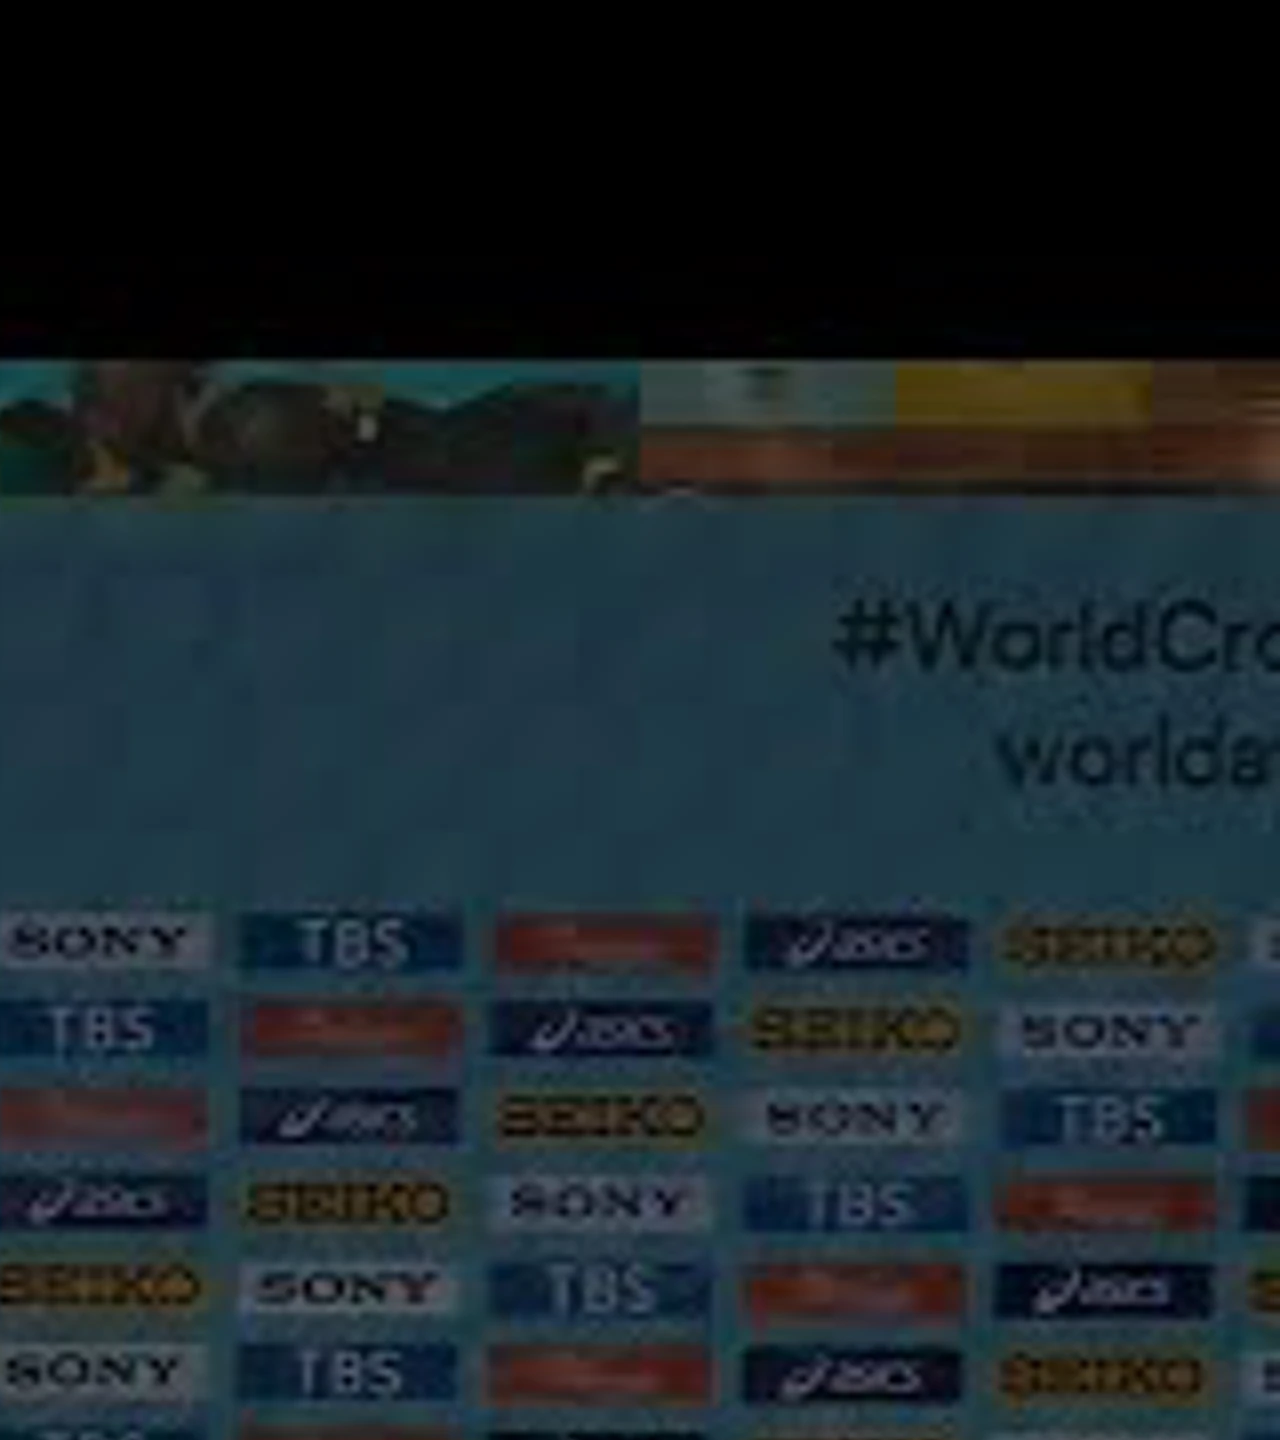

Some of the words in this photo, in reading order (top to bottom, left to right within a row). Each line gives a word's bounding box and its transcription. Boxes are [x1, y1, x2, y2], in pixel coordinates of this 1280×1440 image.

[9, 924, 188, 958] SONY
[294, 918, 411, 968] TBS
[42, 1004, 159, 1054] TBS
[1018, 1014, 1197, 1048] SONY
[765, 1100, 944, 1134] SONY
[1052, 1093, 1169, 1143] TBS
[509, 1185, 688, 1219] SONY
[799, 1180, 916, 1230] TBS
[256, 1270, 435, 1304] SONY
[543, 1264, 660, 1314] TBS
[3, 1353, 182, 1387] SONY
[289, 1347, 406, 1397] TBS
